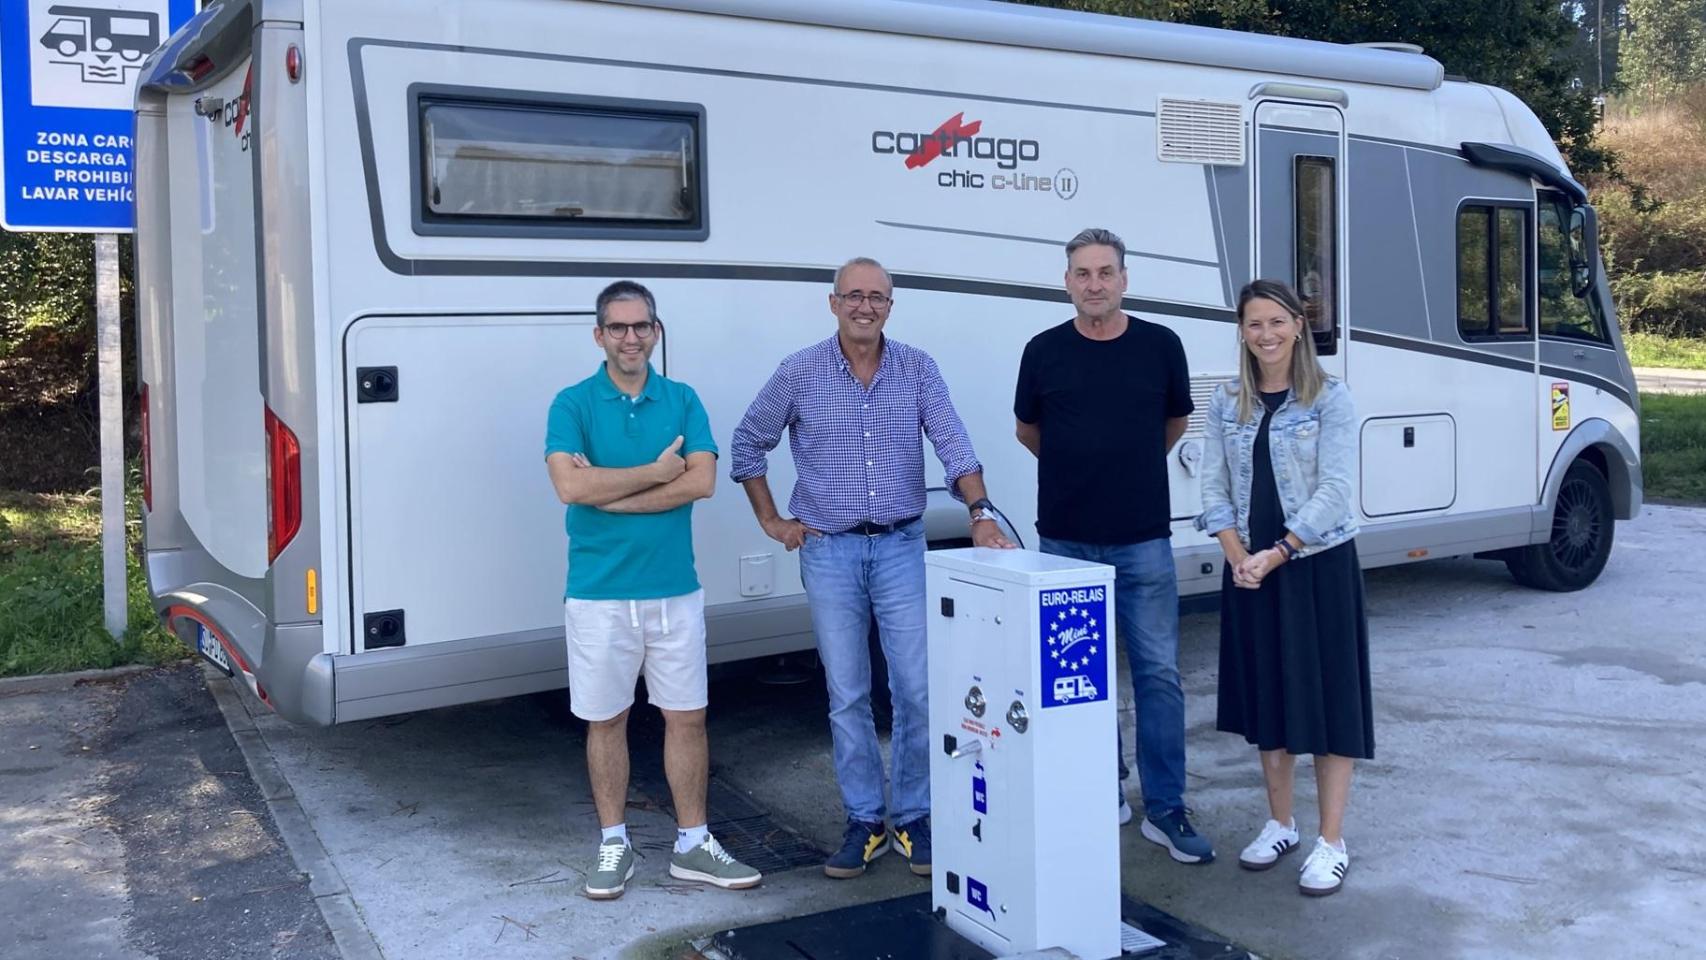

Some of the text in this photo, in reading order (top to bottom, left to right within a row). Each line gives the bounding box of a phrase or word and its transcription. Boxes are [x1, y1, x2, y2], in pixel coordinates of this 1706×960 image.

[37, 132, 133, 149] ZONA CAR
[872, 128, 1039, 169] carthago
[27, 150, 127, 166] DESCARGA
[54, 169, 133, 184] PROHIBI
[938, 169, 984, 188] chic
[991, 173, 1052, 191] c-line
[22, 186, 79, 200] LAVAR
[1041, 588, 1104, 606] EURO-RELAIS
[1058, 624, 1088, 646] Mini
